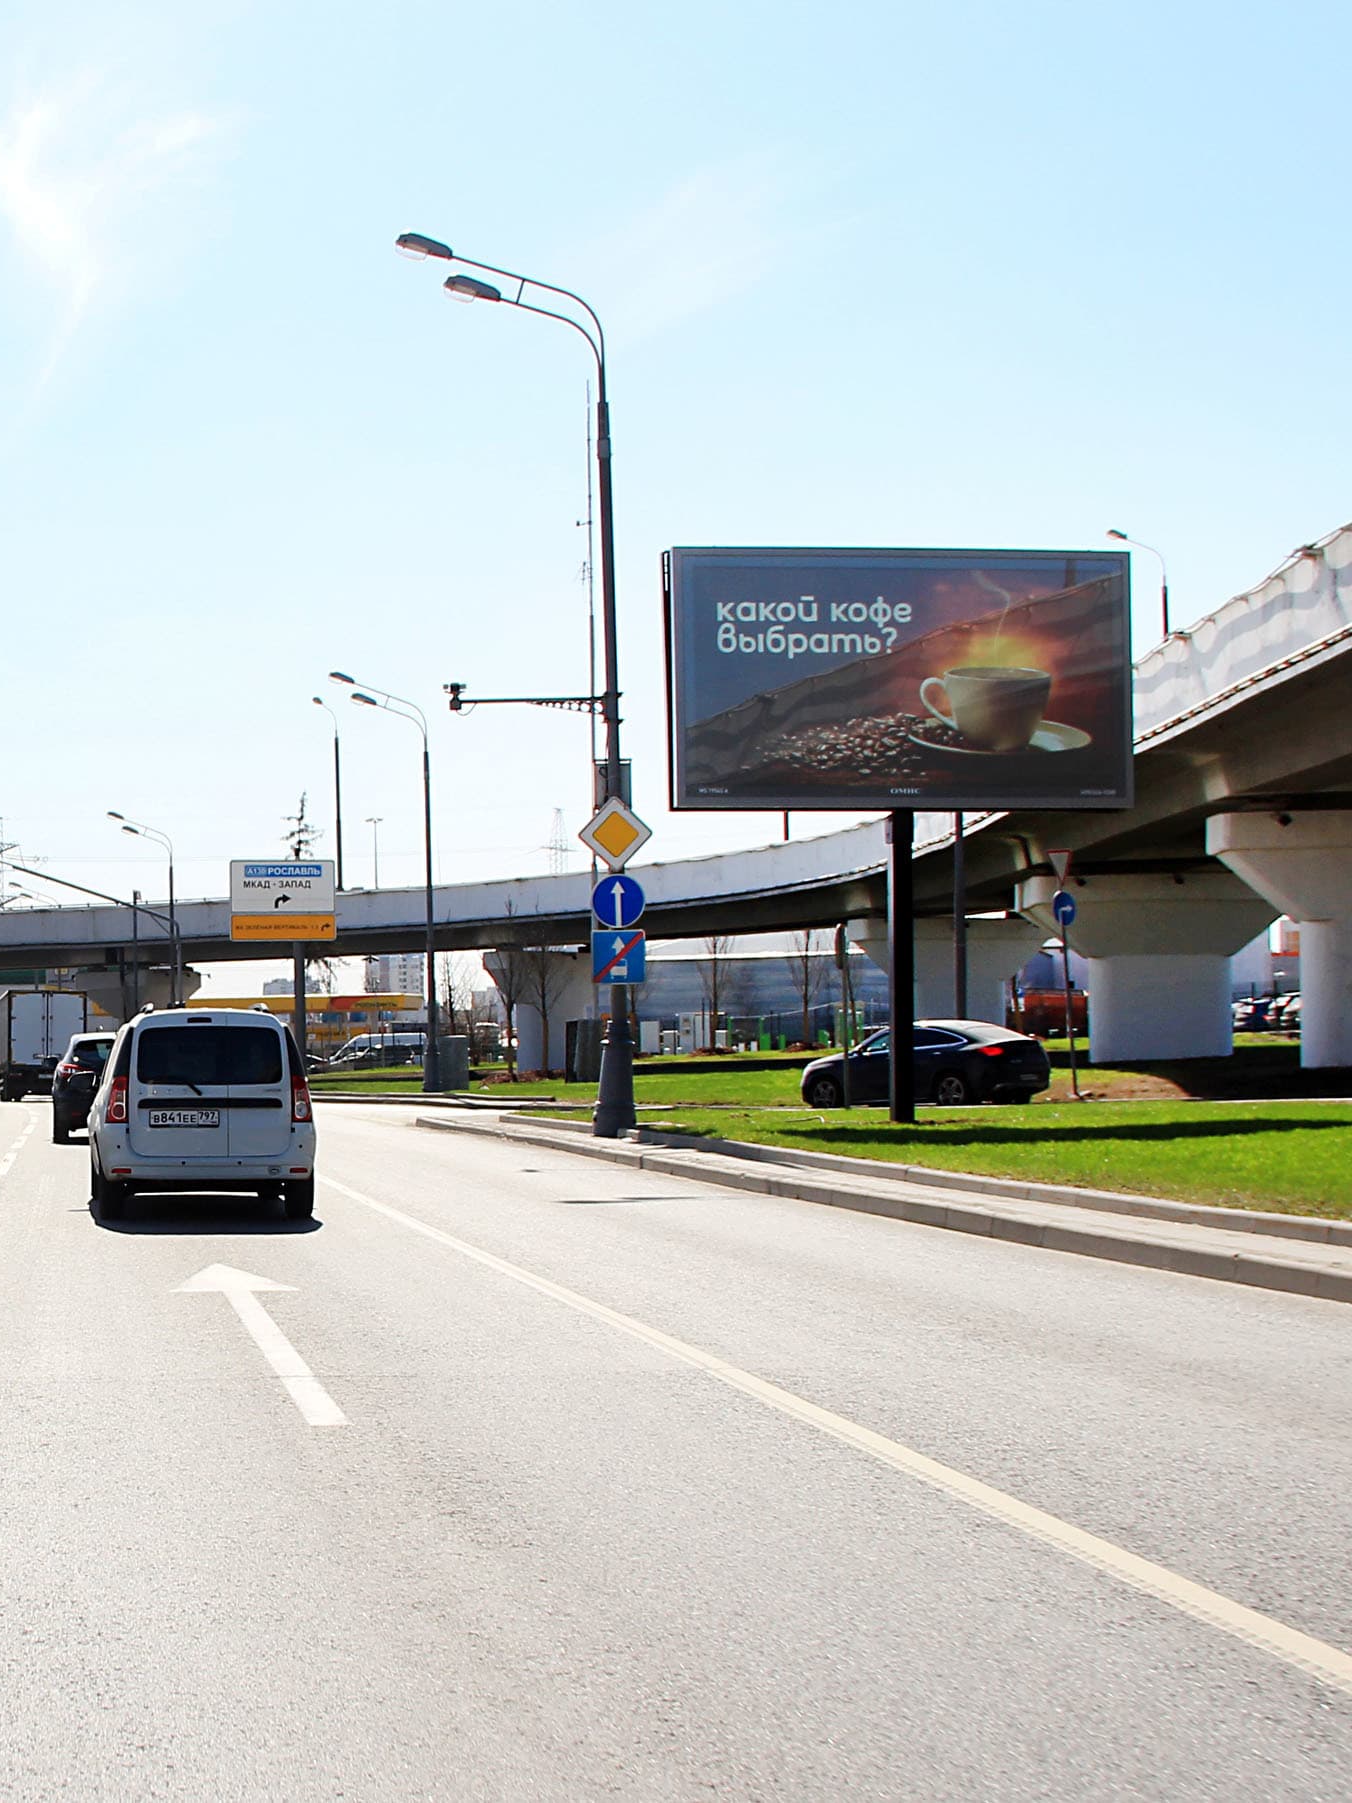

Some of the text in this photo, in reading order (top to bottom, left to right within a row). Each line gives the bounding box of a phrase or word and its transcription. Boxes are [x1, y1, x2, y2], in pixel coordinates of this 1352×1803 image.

[716, 596, 912, 628] какой кофе
[717, 622, 897, 659] выбрать?
[268, 867, 321, 876] РОСЛАВЛЬ
[243, 880, 270, 889] МКАД
[278, 880, 311, 889] ЗАПАД
